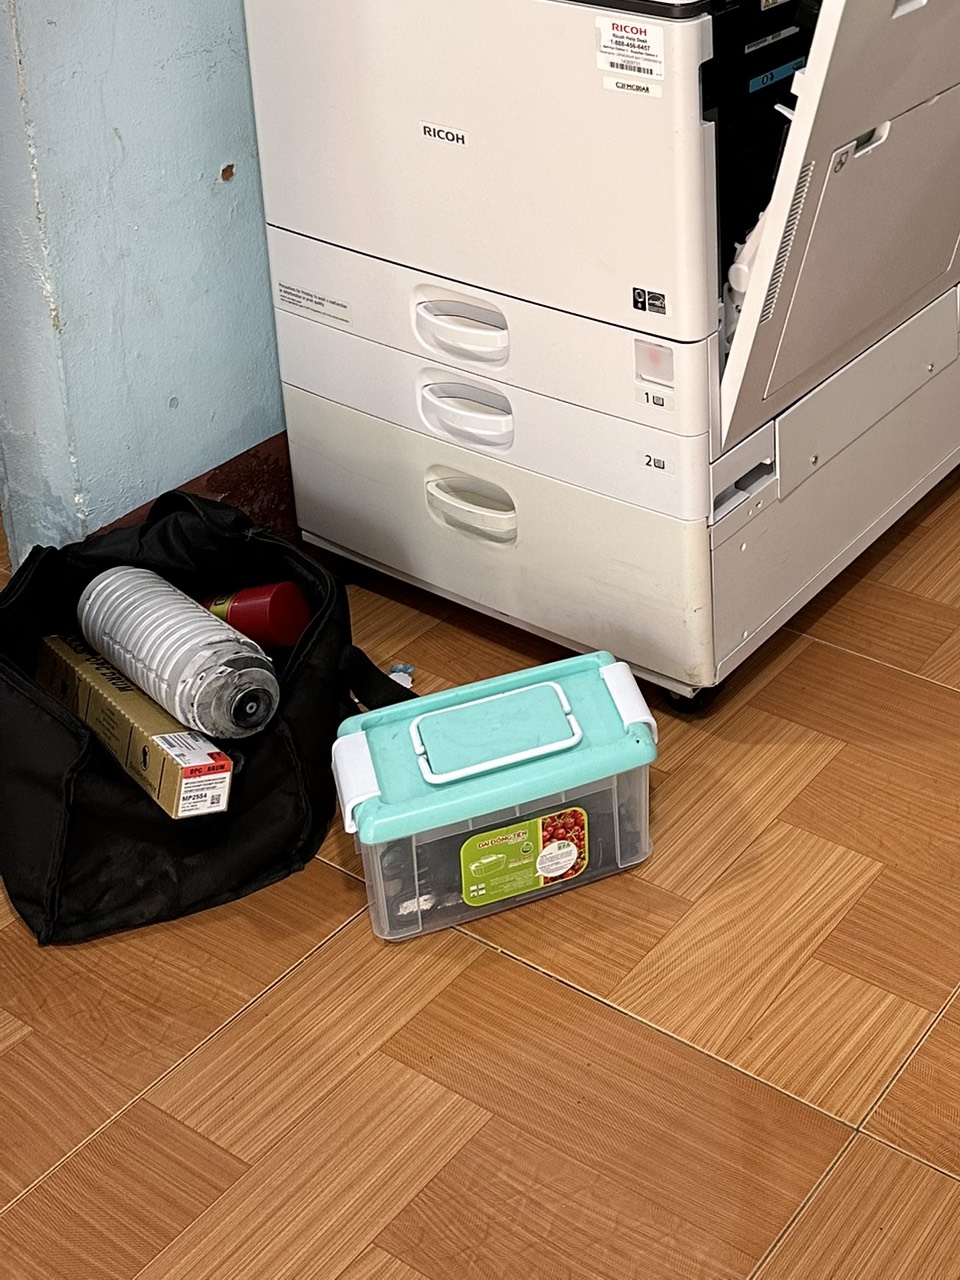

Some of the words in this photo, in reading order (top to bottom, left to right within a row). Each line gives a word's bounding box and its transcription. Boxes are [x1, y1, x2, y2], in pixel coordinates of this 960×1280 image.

[612, 23, 647, 36] RICOH
[423, 126, 465, 145] RICOH
[645, 392, 649, 403] 1
[645, 454, 652, 467] 2
[100, 671, 134, 693] DRUM
[190, 767, 203, 775] OPC
[182, 792, 207, 802] MP2554
